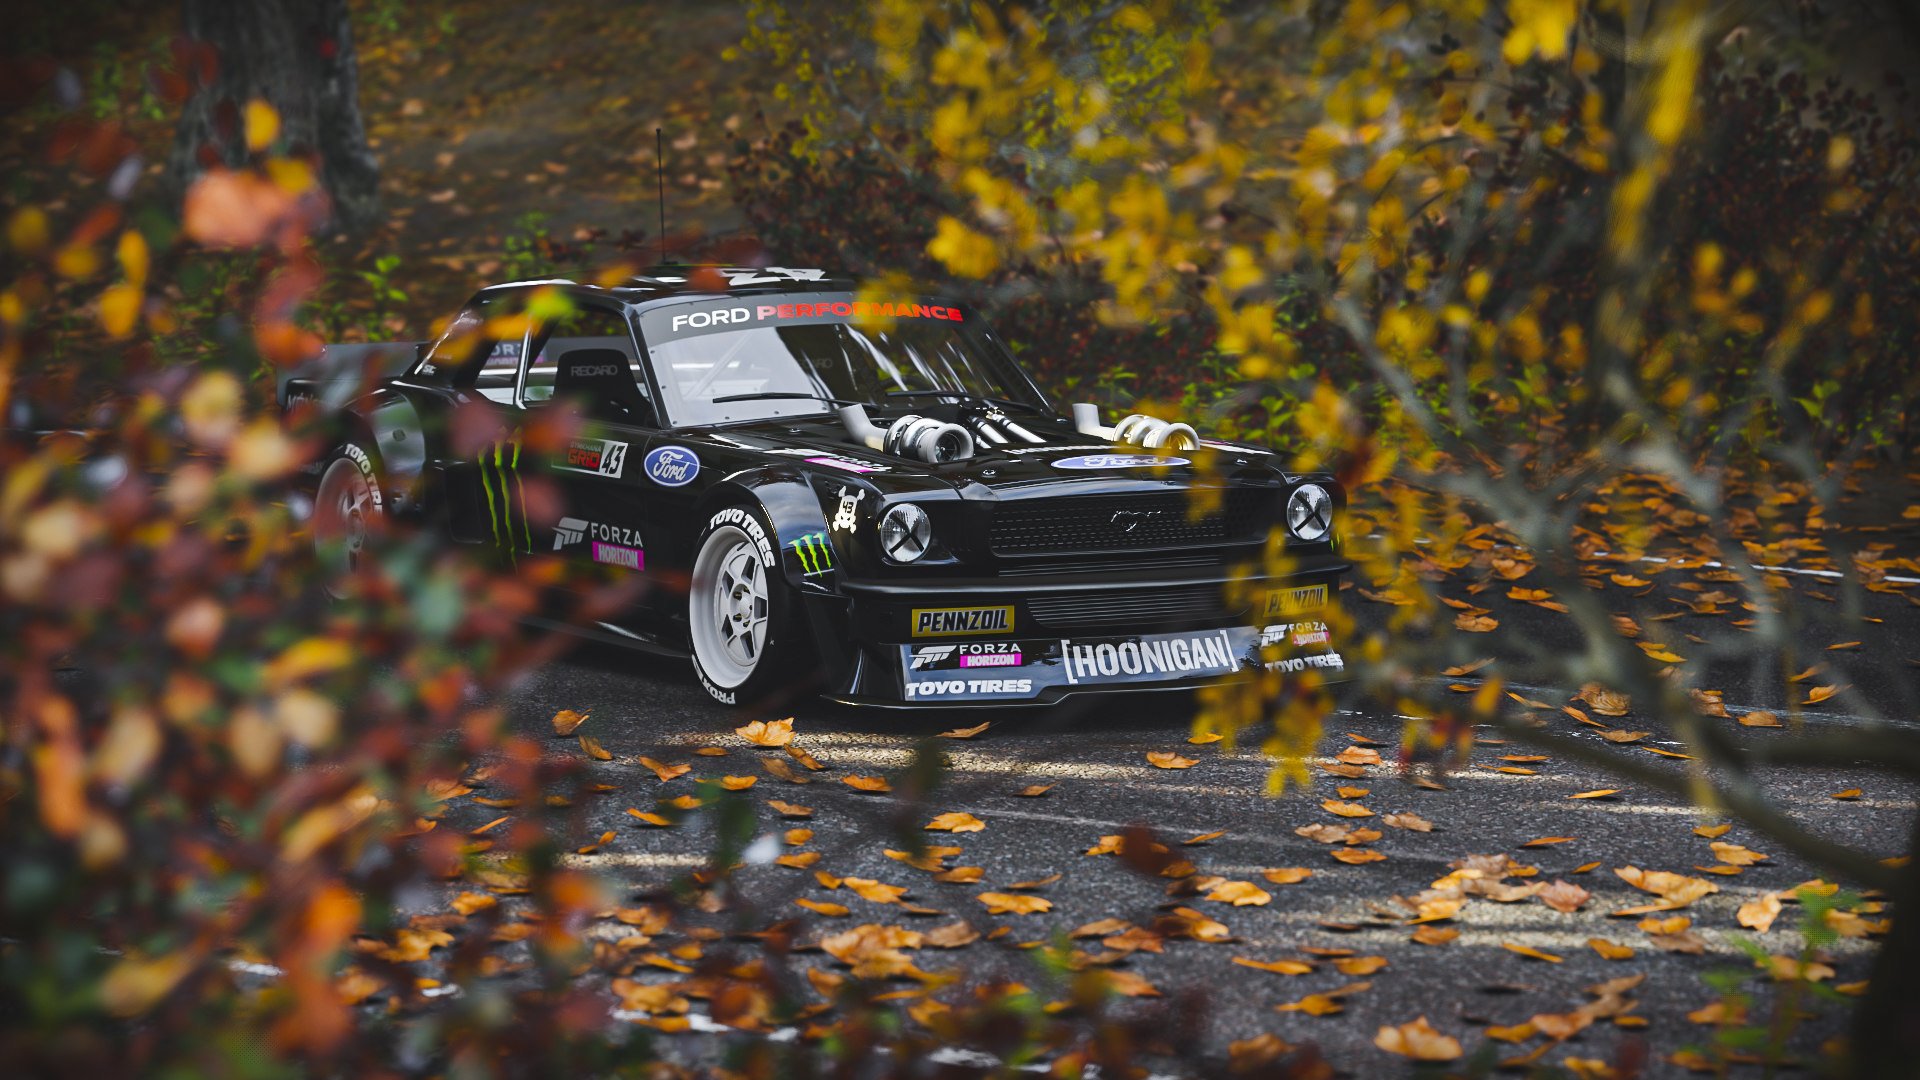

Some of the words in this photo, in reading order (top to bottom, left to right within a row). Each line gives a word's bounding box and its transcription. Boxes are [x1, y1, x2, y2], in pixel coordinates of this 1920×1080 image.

[672, 307, 750, 331] FORD
[756, 301, 964, 322] PERFORMANCE
[571, 365, 618, 377] RECARO
[345, 443, 371, 474] TOYO
[601, 445, 626, 474] 43
[653, 450, 689, 481] Ford
[842, 501, 854, 514] 43
[590, 522, 644, 548] FORZA
[710, 508, 745, 530] TOYO
[742, 514, 776, 568] TIRES
[598, 544, 639, 567] HORIZON
[917, 609, 1009, 633] PENNZOIL
[1288, 621, 1328, 633] FORZA
[959, 643, 1022, 655] FORZA
[967, 654, 1015, 667] HORIZON
[905, 680, 966, 697] TOYO
[967, 679, 1032, 693] TIRES
